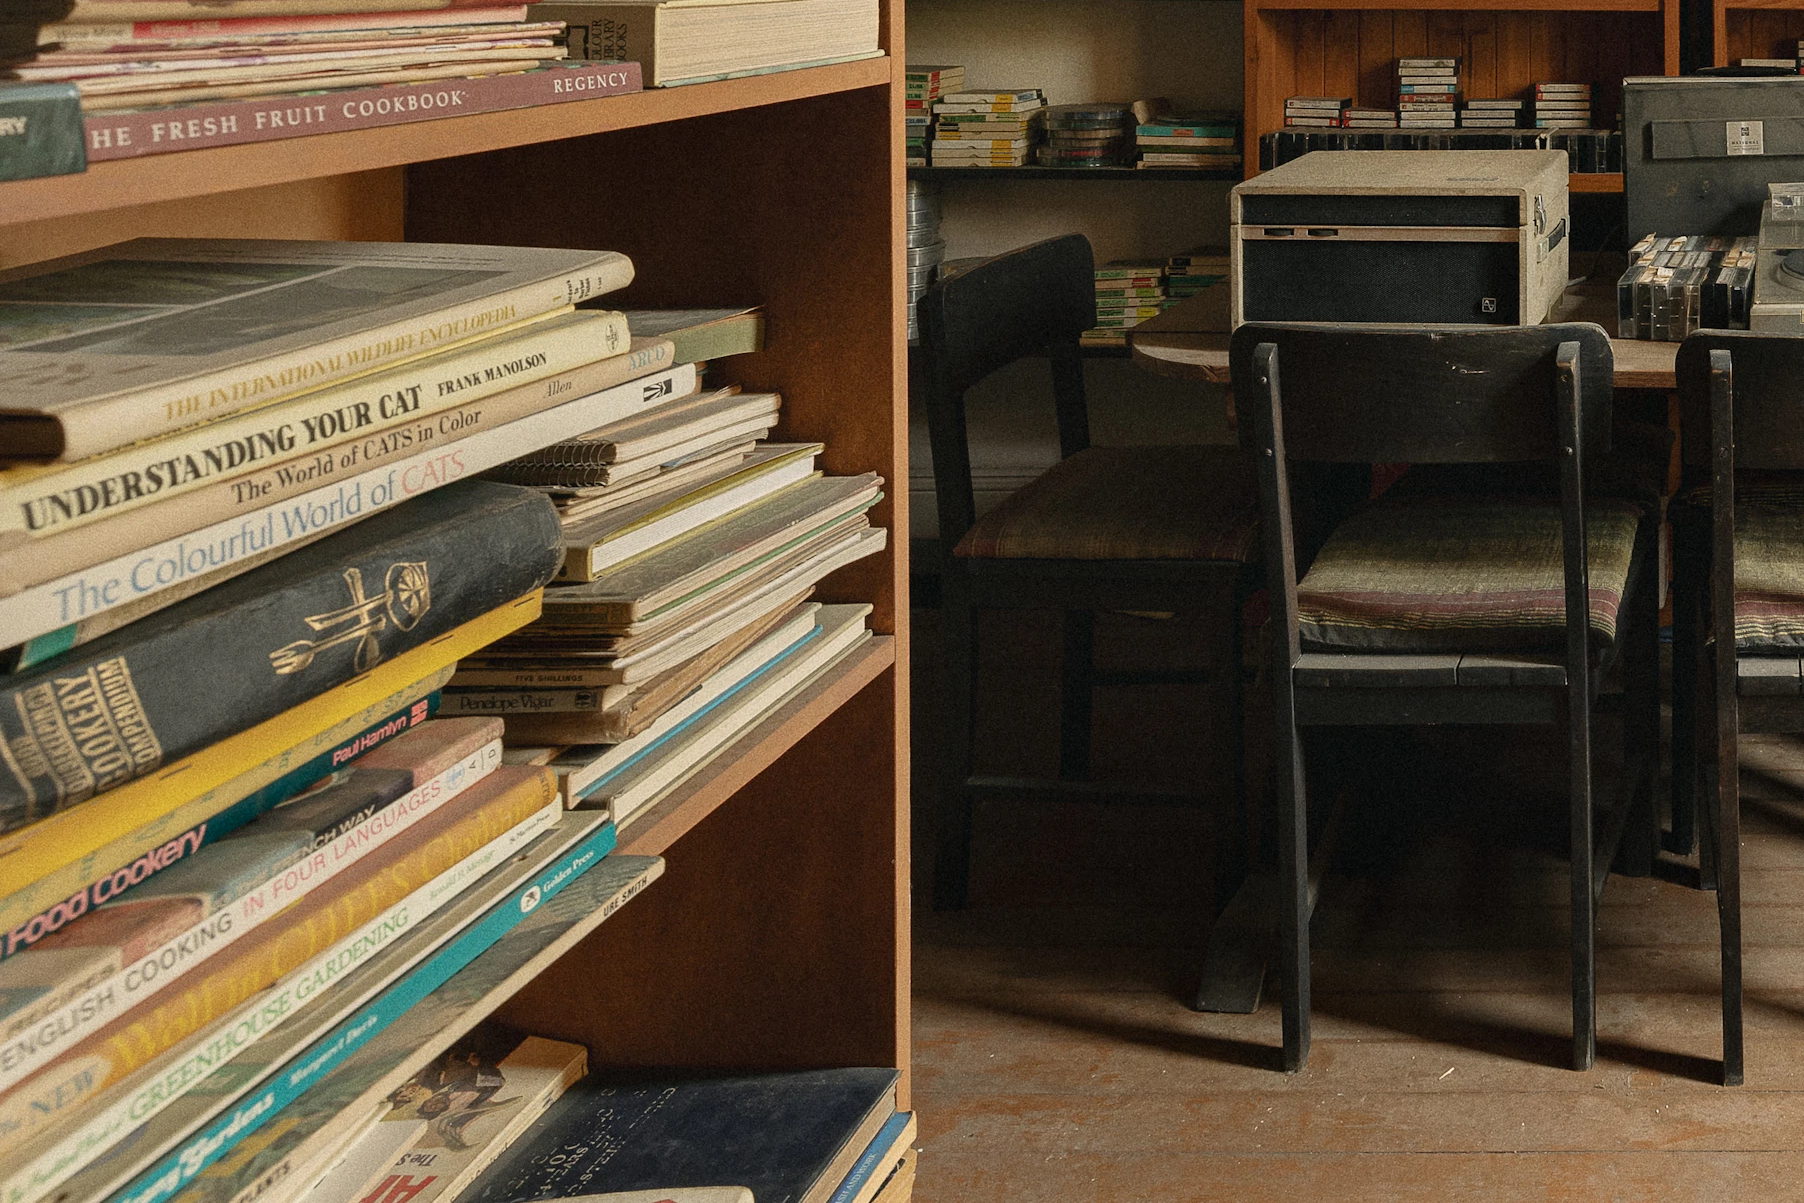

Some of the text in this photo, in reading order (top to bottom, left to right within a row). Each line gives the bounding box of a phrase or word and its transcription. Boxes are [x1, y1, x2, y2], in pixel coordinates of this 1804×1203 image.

[590, 19, 603, 61] OLOUR
[552, 71, 630, 95] REGENCY
[91, 90, 464, 150] HE FRESH FRUIT COOKBOOK
[162, 398, 203, 422] THE
[205, 355, 343, 410] INTERNATIONAL
[343, 333, 420, 369] WILDLIFE
[418, 303, 518, 347] ENCYCLOPEDIA
[436, 350, 549, 398] FRANK MANOLSON
[545, 377, 574, 400] Allen
[19, 382, 425, 532] UNDERSTANDING YOUR CAT
[230, 408, 483, 505] The World of CATS in Color
[50, 447, 467, 624] The Colourful World of CATS
[514, 674, 535, 683] FIVE
[458, 694, 556, 712] Penelope Vigar
[332, 713, 408, 768] Paul Hamlyn
[338, 804, 377, 836] WAY
[7, 890, 90, 954] Food
[91, 822, 208, 905] Cookery
[542, 849, 595, 894] Golden Press
[602, 874, 649, 918] URE SMITH
[0, 988, 116, 1074] ENGLISH
[124, 911, 234, 994] COOKING
[241, 893, 266, 920] IN
[272, 851, 333, 905] FOUR
[333, 779, 443, 861] LANGUAGES
[127, 990, 294, 1122] GREENHOUSE
[294, 906, 411, 1002] GARDENING
[845, 1172, 862, 1190] AND
[852, 1152, 879, 1178] WORK
